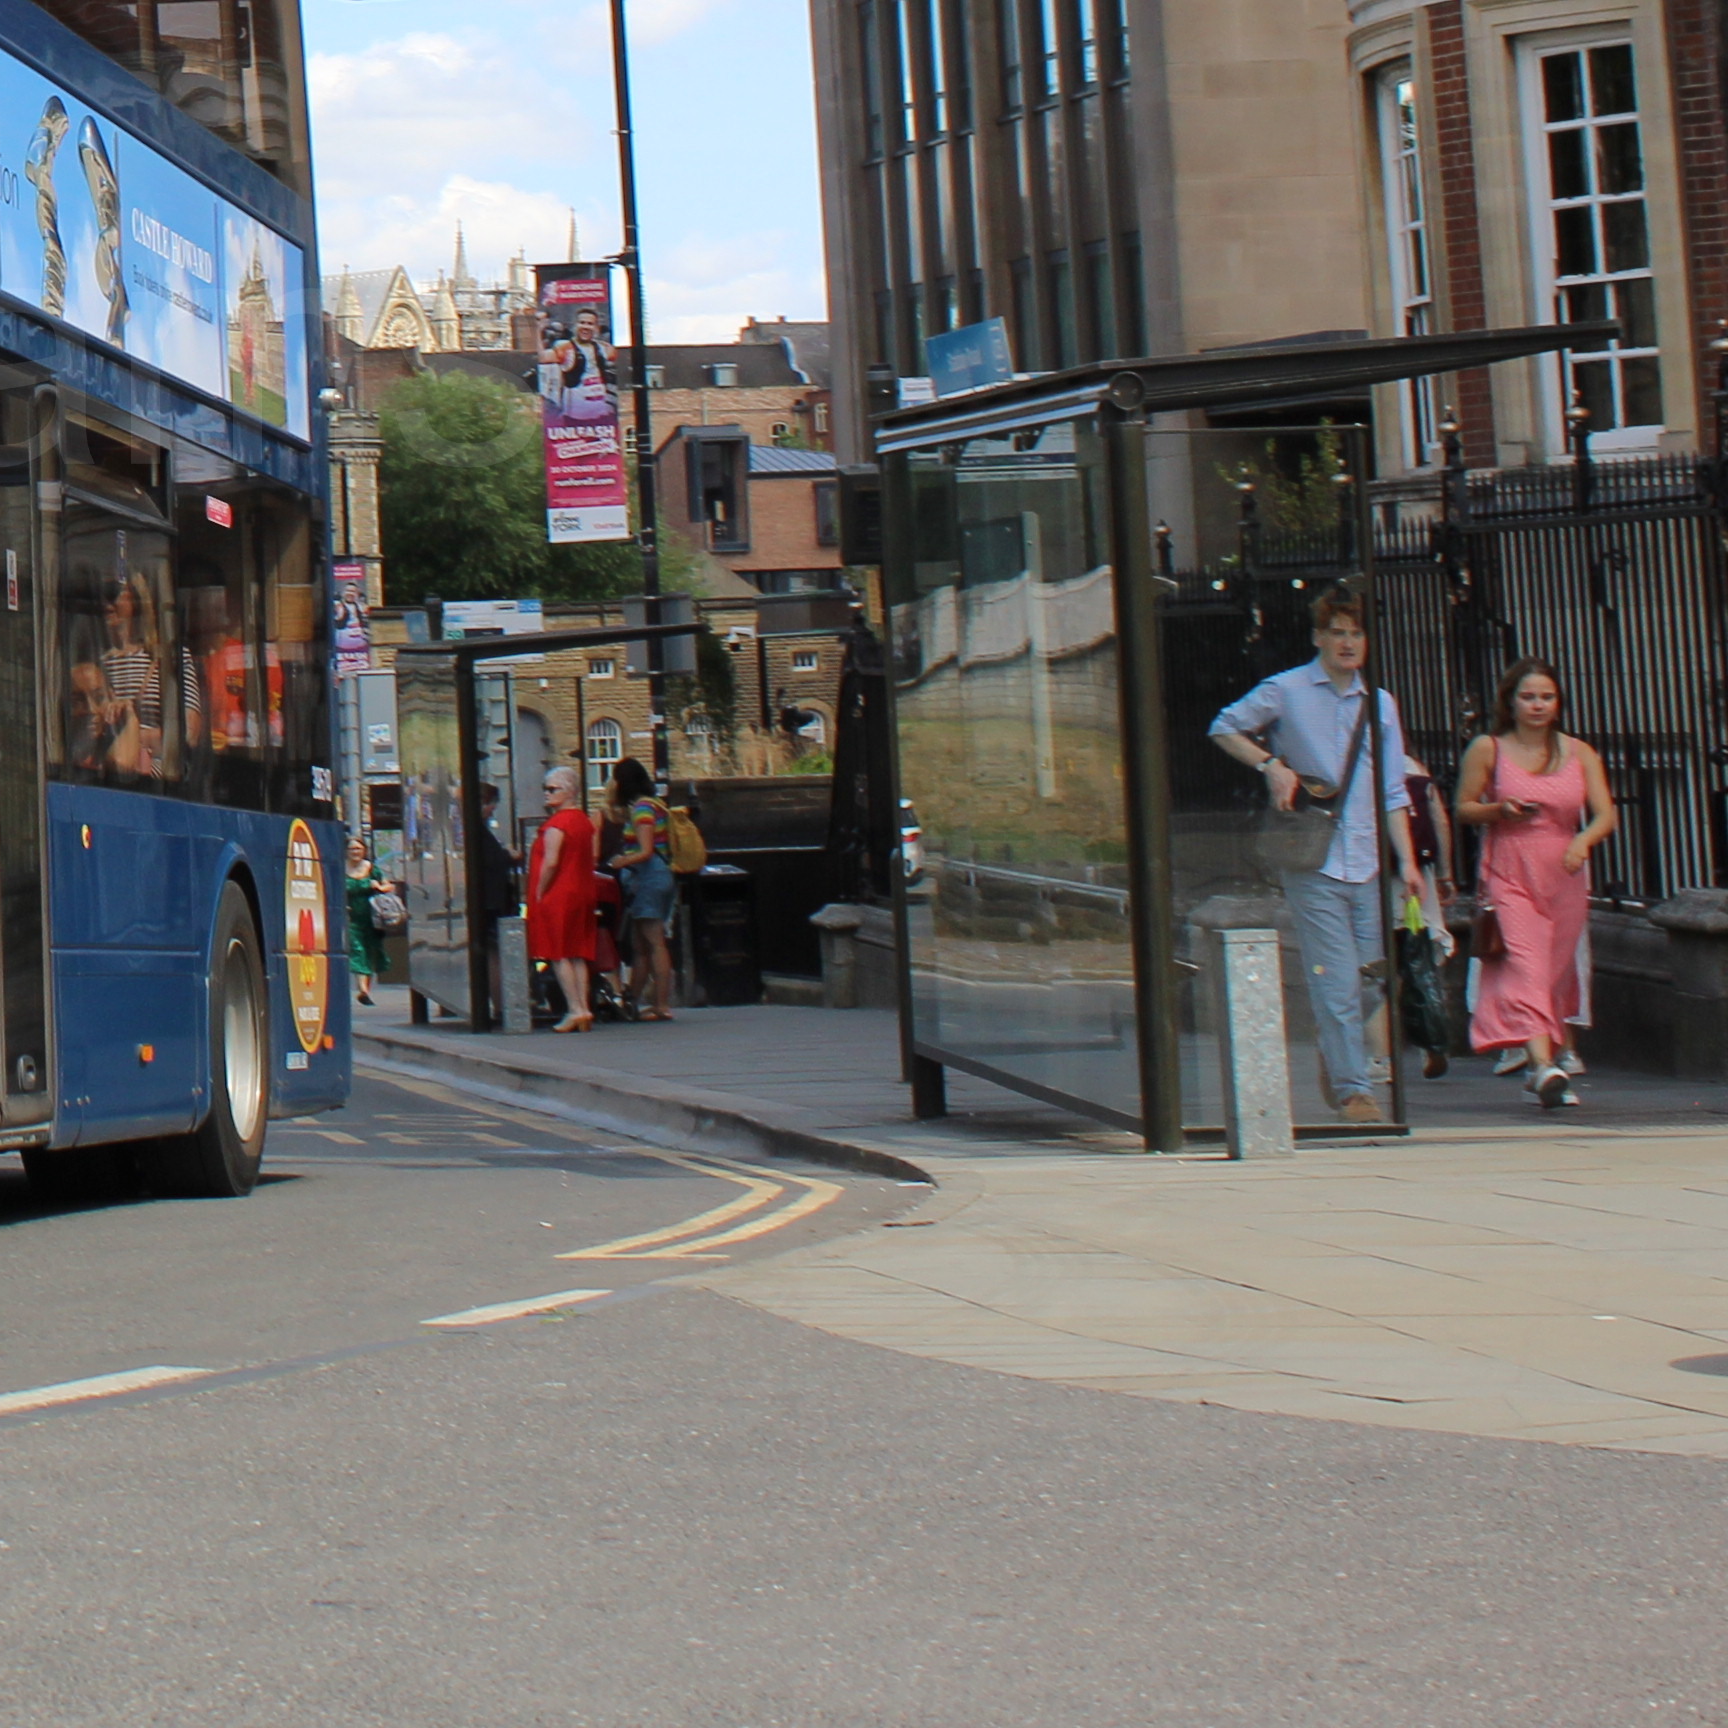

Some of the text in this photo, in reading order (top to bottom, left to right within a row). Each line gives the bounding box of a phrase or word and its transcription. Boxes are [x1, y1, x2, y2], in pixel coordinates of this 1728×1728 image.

[132, 207, 212, 284] CASTLE HOWARD
[547, 425, 615, 440] UNLEASH
